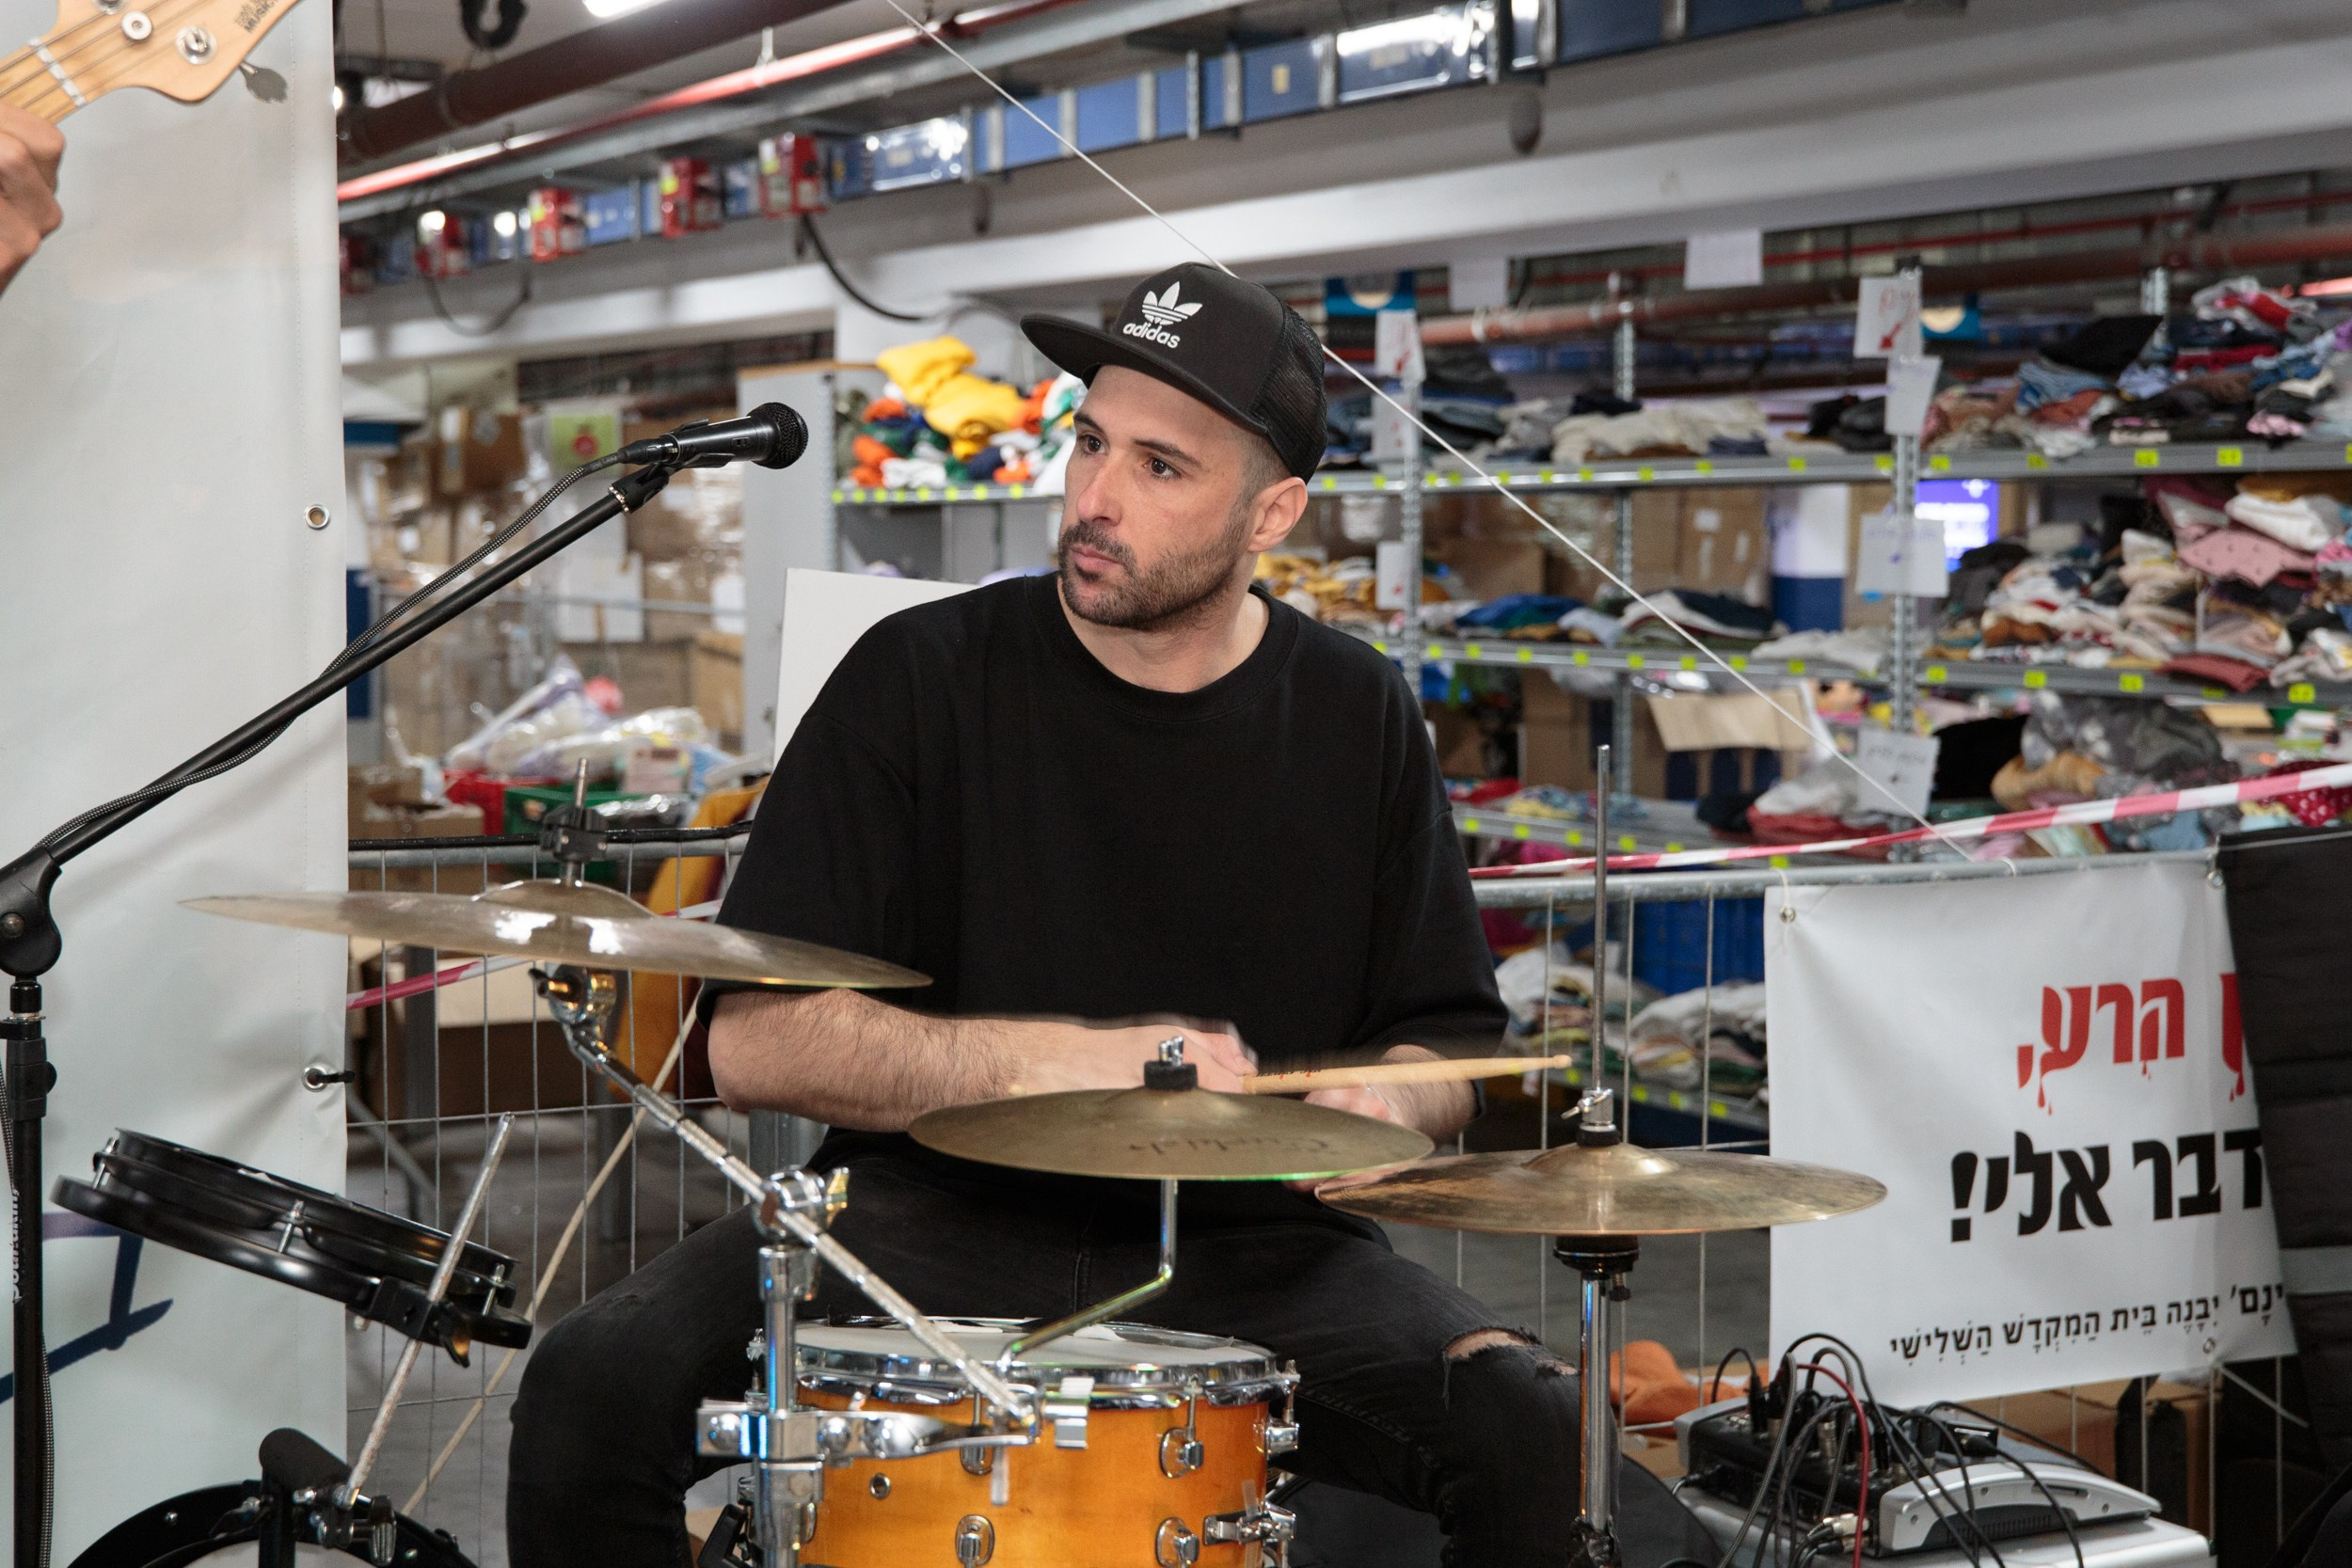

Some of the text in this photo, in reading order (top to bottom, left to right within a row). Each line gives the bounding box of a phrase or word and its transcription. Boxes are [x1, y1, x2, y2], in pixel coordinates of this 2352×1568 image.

[1122, 322, 1182, 349] adidas
[2017, 977, 2185, 1091] הרע,
[1950, 1131, 2113, 1243] אלי!
